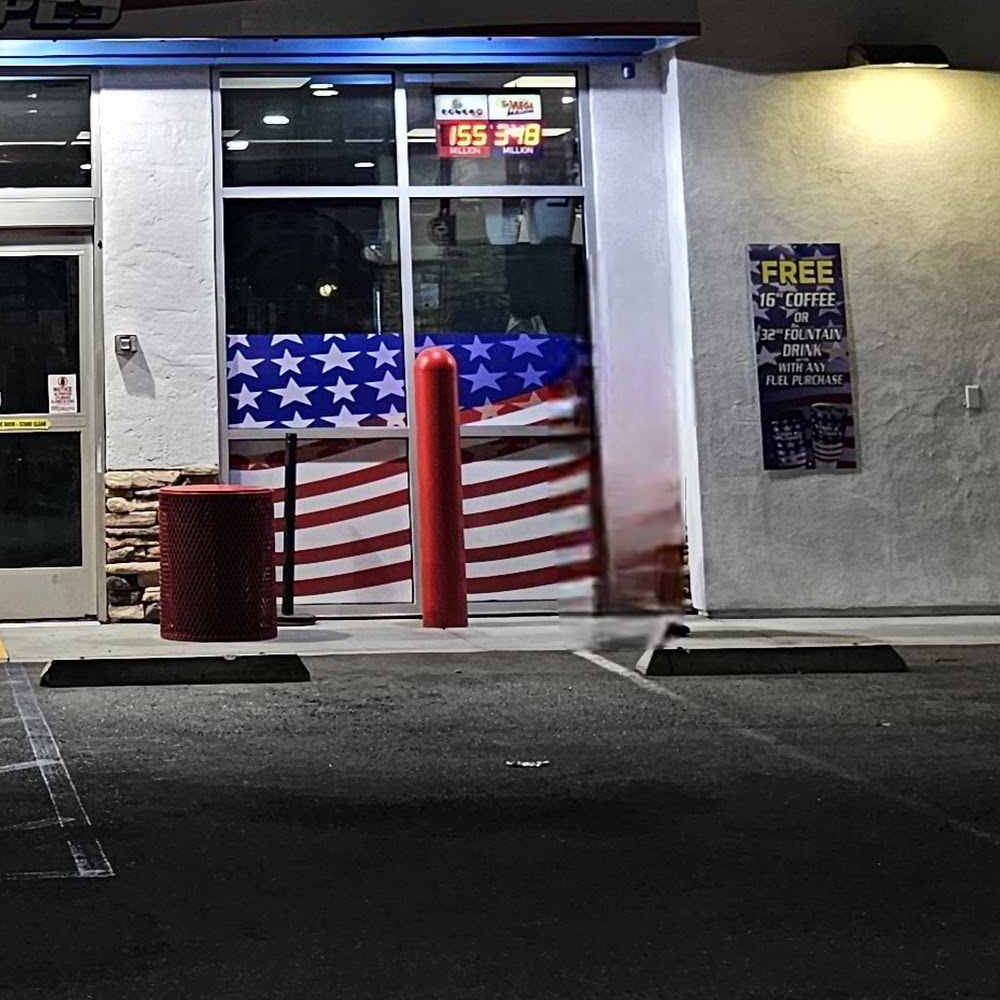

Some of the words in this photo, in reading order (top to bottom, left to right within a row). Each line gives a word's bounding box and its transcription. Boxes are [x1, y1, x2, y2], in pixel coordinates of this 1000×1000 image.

[449, 124, 487, 146] 155
[761, 260, 834, 284] FREE
[785, 292, 836, 307] COFFEE
[793, 312, 809, 323] OR
[784, 328, 842, 340] FOUNTAIN
[783, 344, 822, 357] DRINK
[778, 363, 803, 373] WITH
[805, 362, 826, 373] ANY
[766, 375, 789, 386] FUEL
[792, 375, 843, 385] PURCHASE
